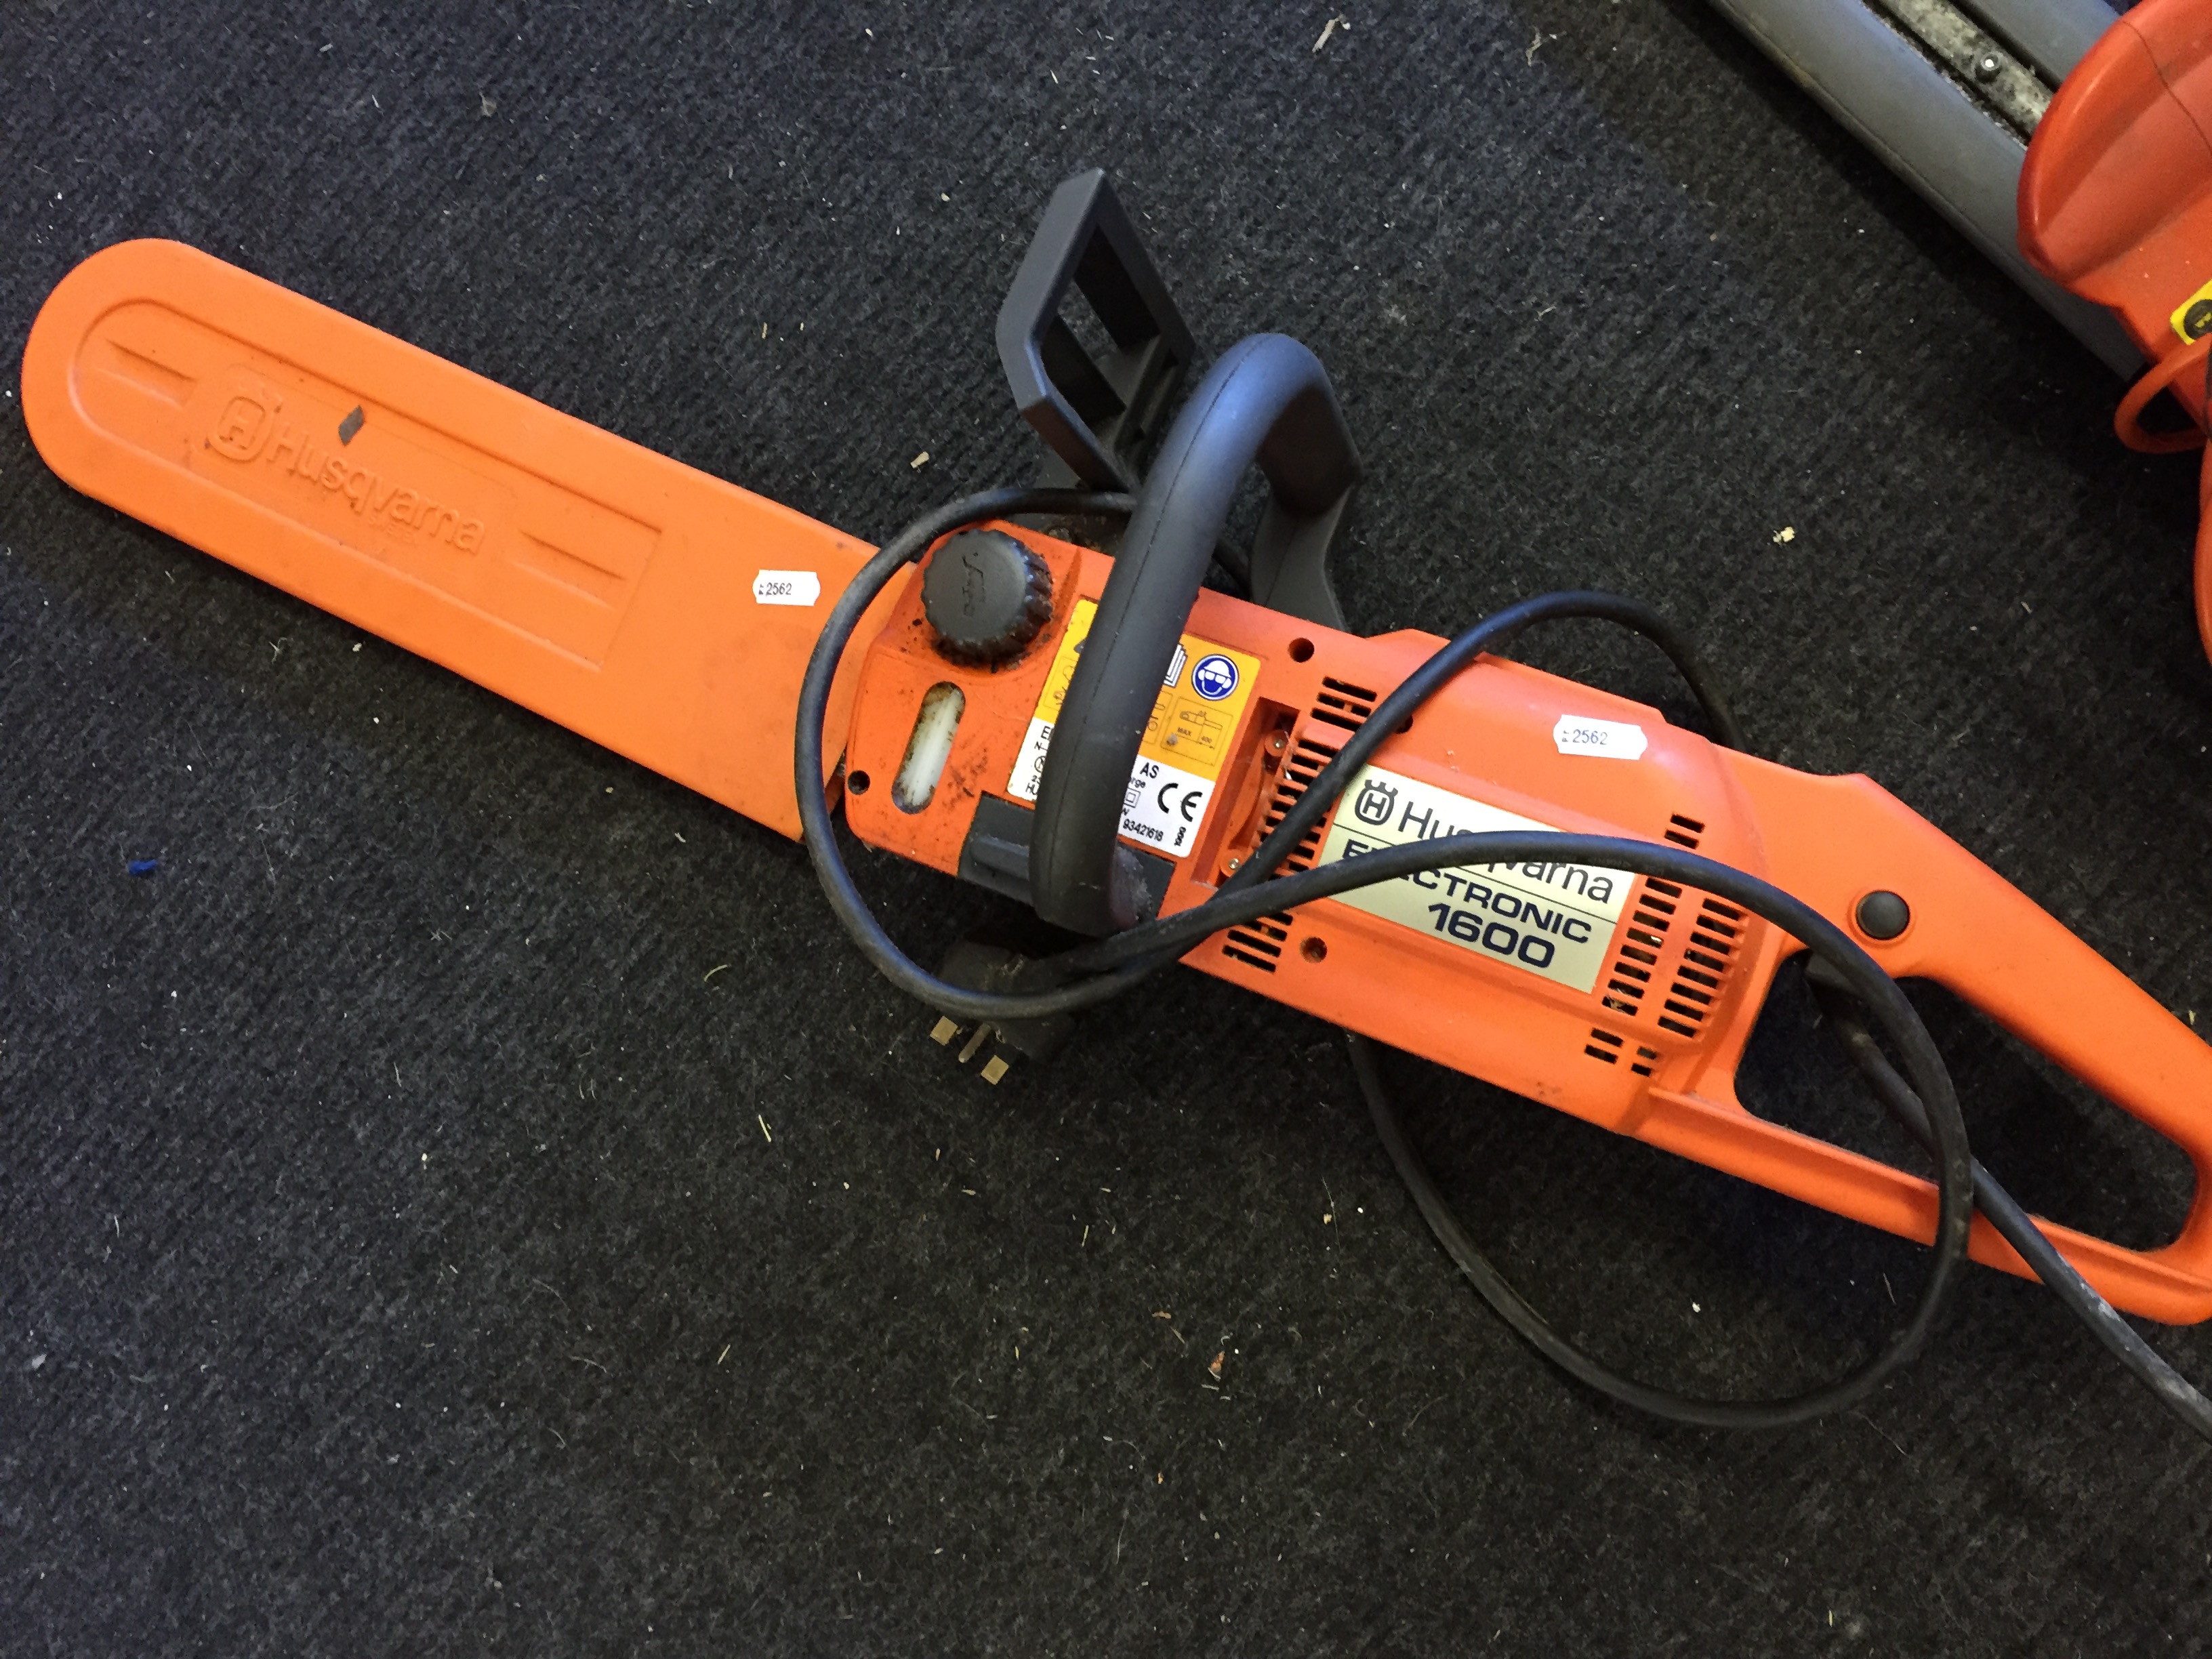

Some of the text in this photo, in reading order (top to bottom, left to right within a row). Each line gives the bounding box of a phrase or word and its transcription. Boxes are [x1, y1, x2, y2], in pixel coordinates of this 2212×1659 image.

[266, 420, 486, 556] Husqvarna
[765, 581, 792, 596] 2562
[1572, 729, 1608, 745] 2562
[1139, 762, 1160, 779] AS
[1157, 782, 1204, 823] CE
[1397, 800, 1614, 905] Huarna
[1342, 838, 1592, 944] ECTRONIC
[1428, 902, 1556, 968] 1600
